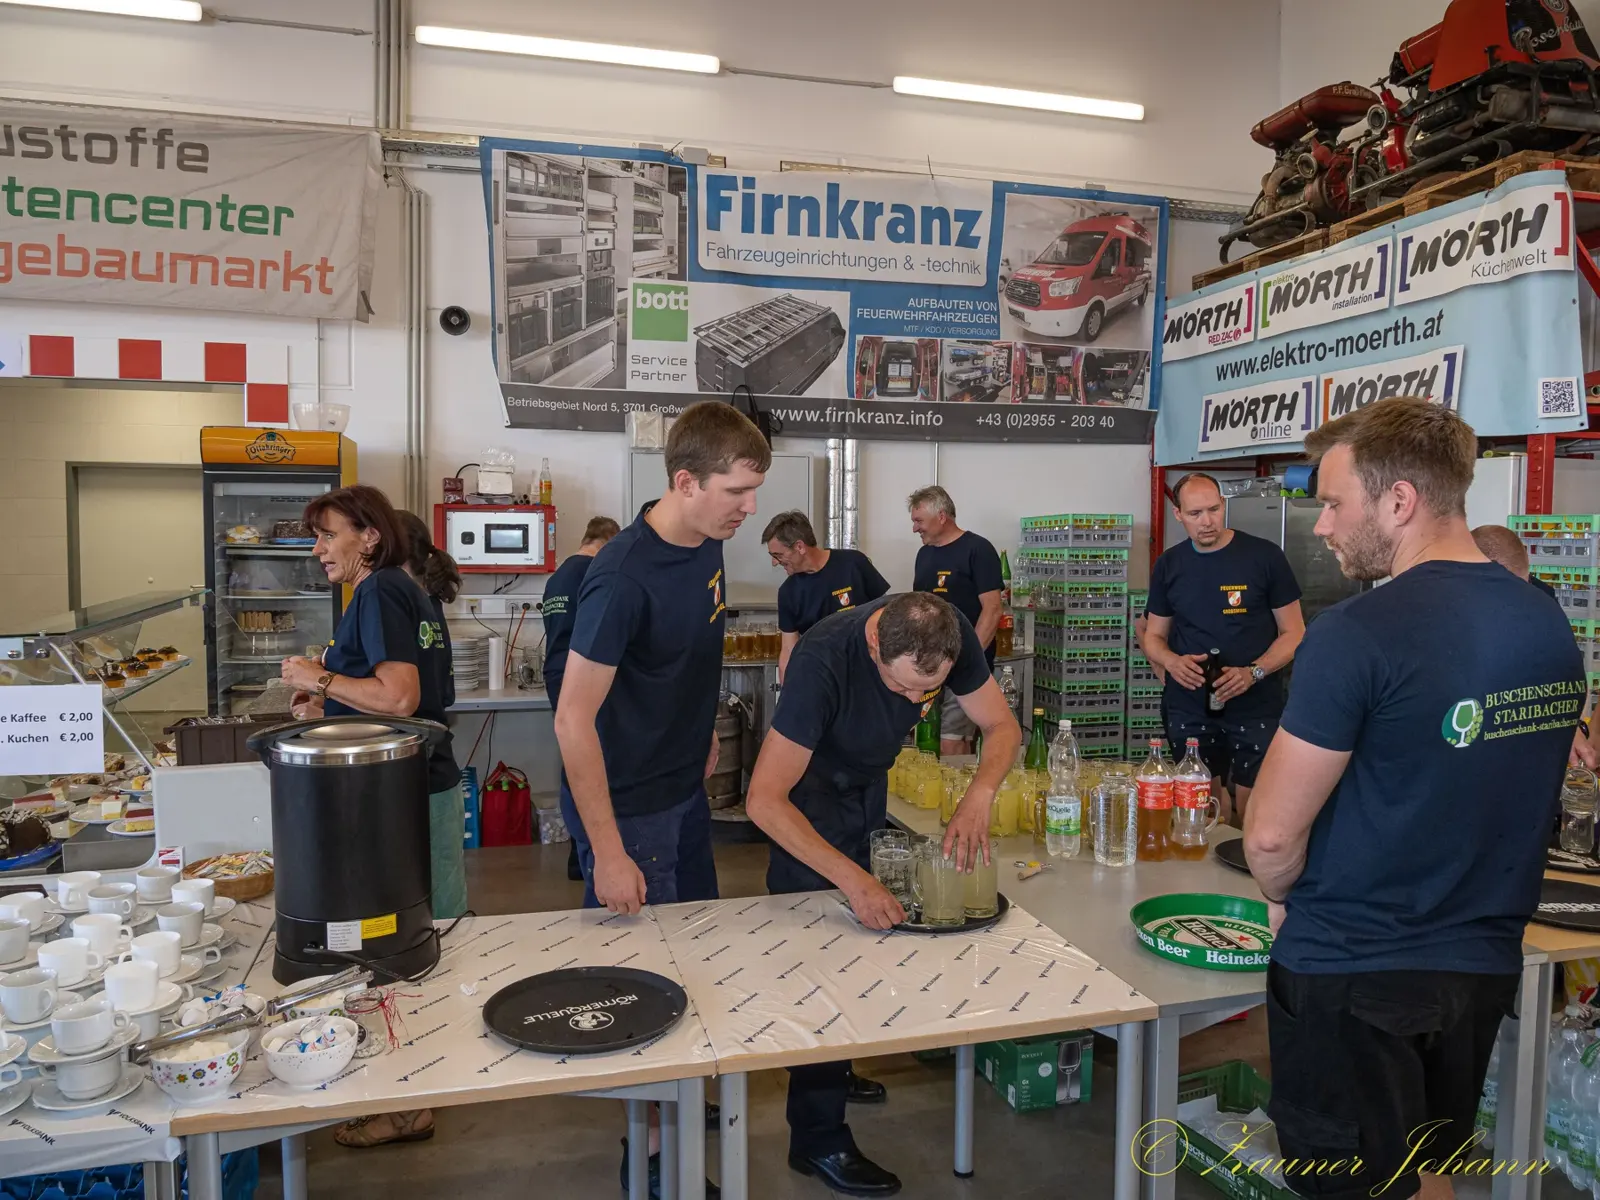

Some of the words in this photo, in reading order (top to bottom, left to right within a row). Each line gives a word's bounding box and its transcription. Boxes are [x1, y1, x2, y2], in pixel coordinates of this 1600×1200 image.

[2, 176, 295, 237] tencenter
[705, 173, 983, 249] Firnkranz
[1410, 203, 1549, 278] MÖRTH
[706, 241, 899, 272] Fahrzeugeinrichtungen
[903, 255, 915, 271] &
[920, 256, 982, 276] -technik
[1471, 249, 1548, 279] Küchenwelt
[1269, 256, 1374, 316] MÖRTH
[636, 288, 689, 310] bott
[908, 298, 972, 310] AUFBAUTEN
[976, 301, 997, 312] VON
[1332, 292, 1373, 311] installation
[857, 308, 998, 324] FEUERWEHRFAHRZEUGEN
[1163, 297, 1243, 344] MÖRTH
[947, 327, 998, 336] VERSORGUNG
[1208, 334, 1221, 344] RED
[1221, 330, 1233, 341] ZAC
[1217, 309, 1444, 382] www.elektro-moerth.at
[631, 354, 688, 367] Service
[631, 369, 687, 382] Partner
[507, 397, 580, 411] Betriebsgebiet
[583, 402, 608, 412] Nord
[611, 403, 620, 414] 5,
[623, 403, 646, 413] 3701
[650, 404, 686, 415] Großw
[1209, 390, 1299, 432] MÖRTH
[771, 407, 944, 427] www.firnkranz.info
[976, 414, 1001, 427] +43
[1006, 413, 1055, 428] (0)2955
[1071, 415, 1094, 428] 203
[1100, 416, 1115, 428] 40
[10, 713, 47, 723] Kaffee
[59, 713, 66, 721] €
[69, 712, 93, 723] 2,00
[1493, 699, 1579, 725] STARIBACHER
[7, 734, 49, 744] Kuchen
[60, 733, 67, 742] €
[69, 732, 94, 743] 2,00
[1157, 938, 1190, 958] Beer
[1205, 949, 1270, 965] Heineke
